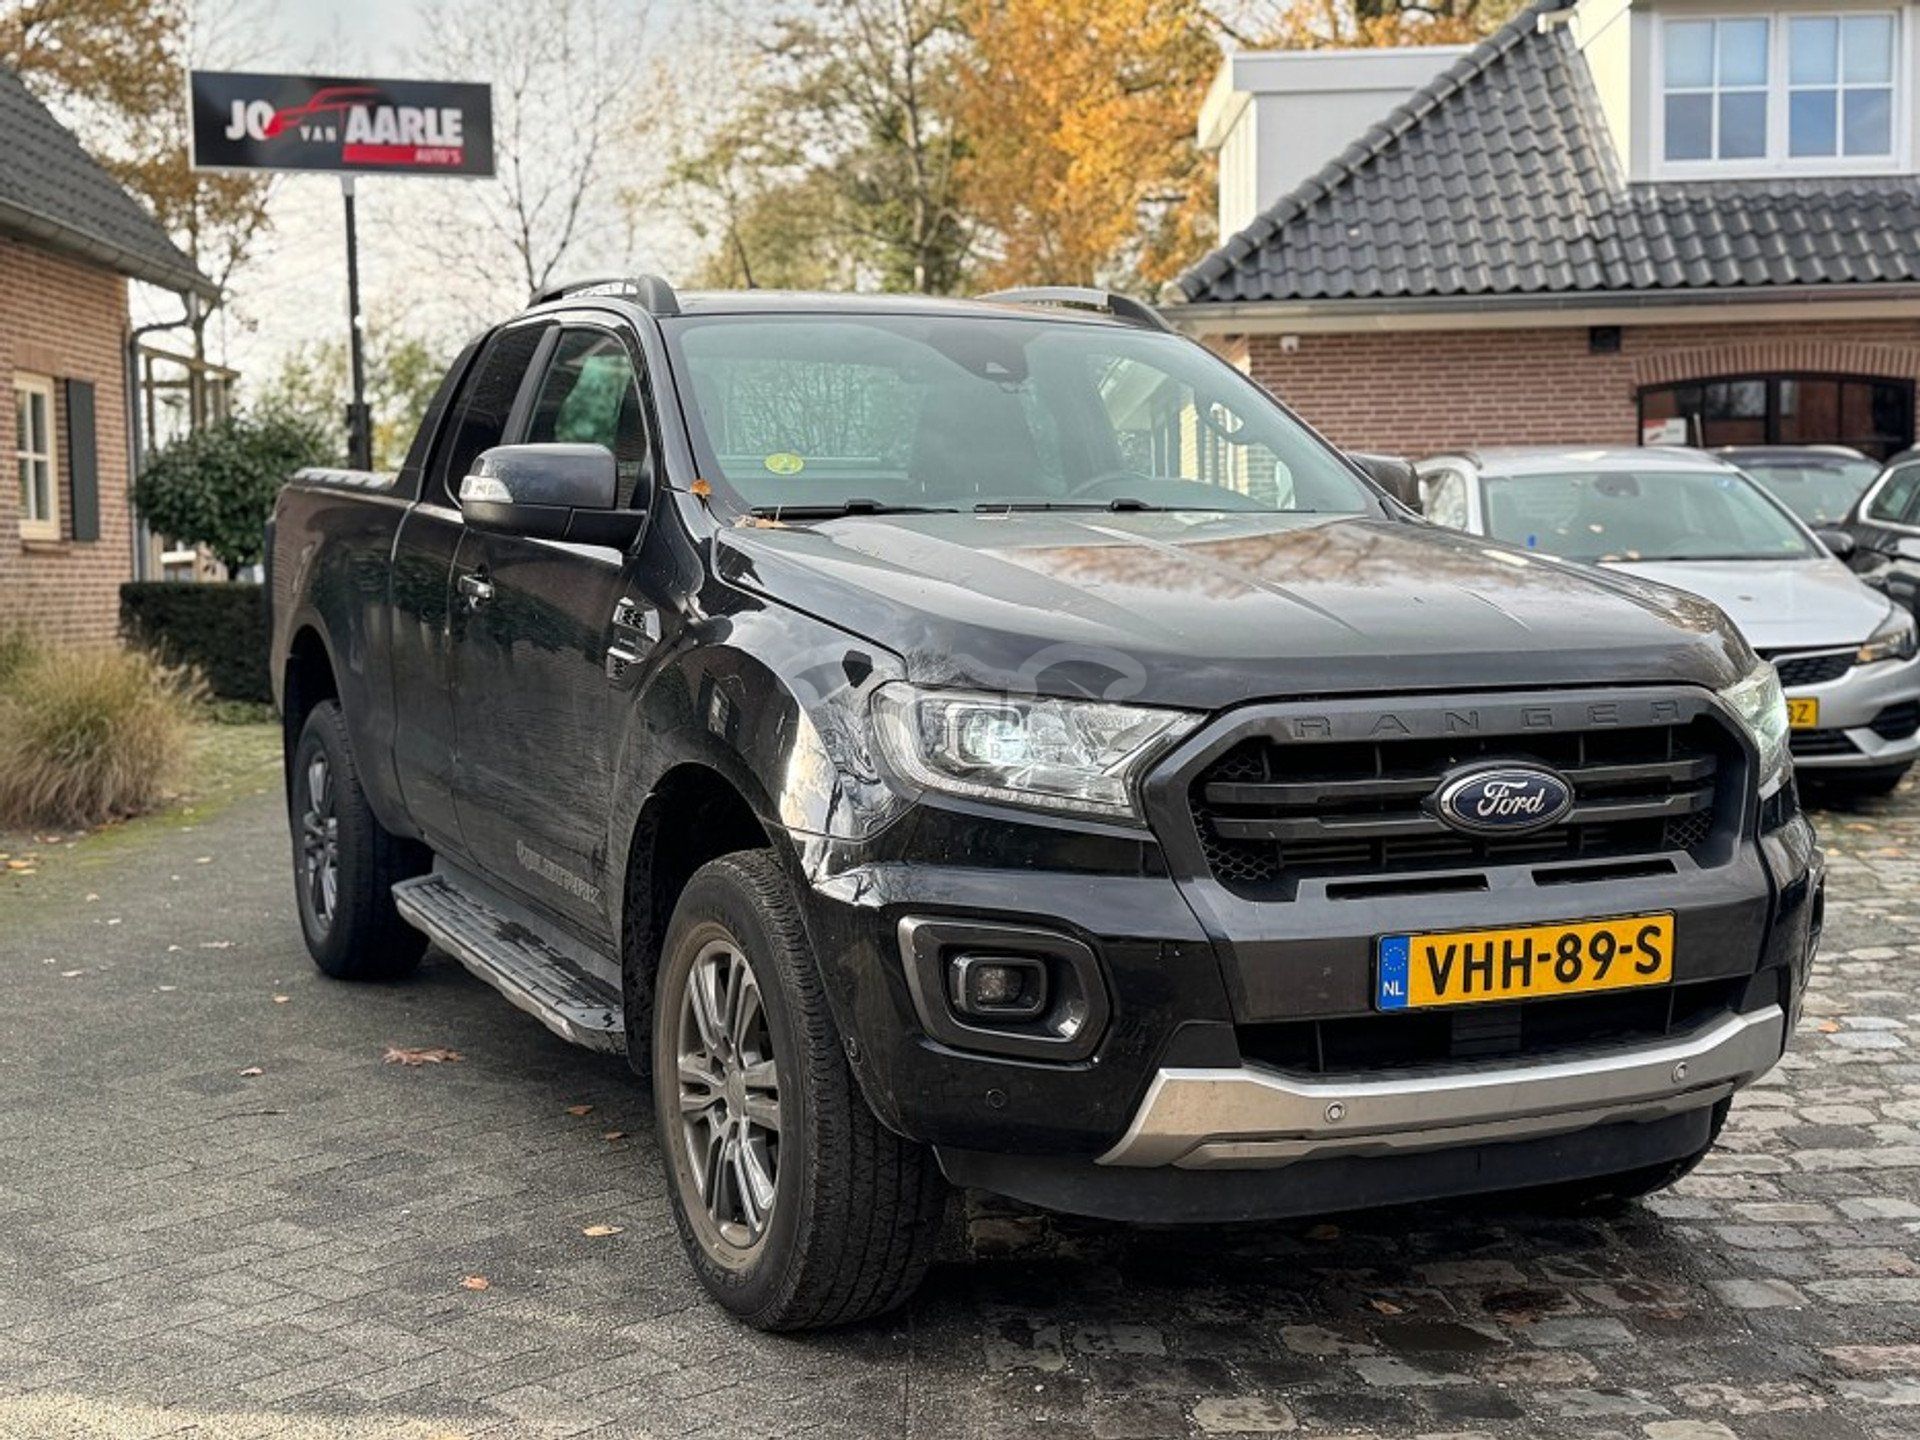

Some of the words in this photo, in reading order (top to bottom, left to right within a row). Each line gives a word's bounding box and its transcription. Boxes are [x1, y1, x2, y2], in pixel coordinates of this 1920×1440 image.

[225, 100, 276, 141] JO
[300, 125, 337, 142] VAN
[344, 105, 464, 147] AARLE
[1293, 701, 1680, 739] RANGER
[1477, 779, 1546, 817] Ford
[1425, 924, 1662, 996] VHH-89-S
[1382, 981, 1404, 997] NL
